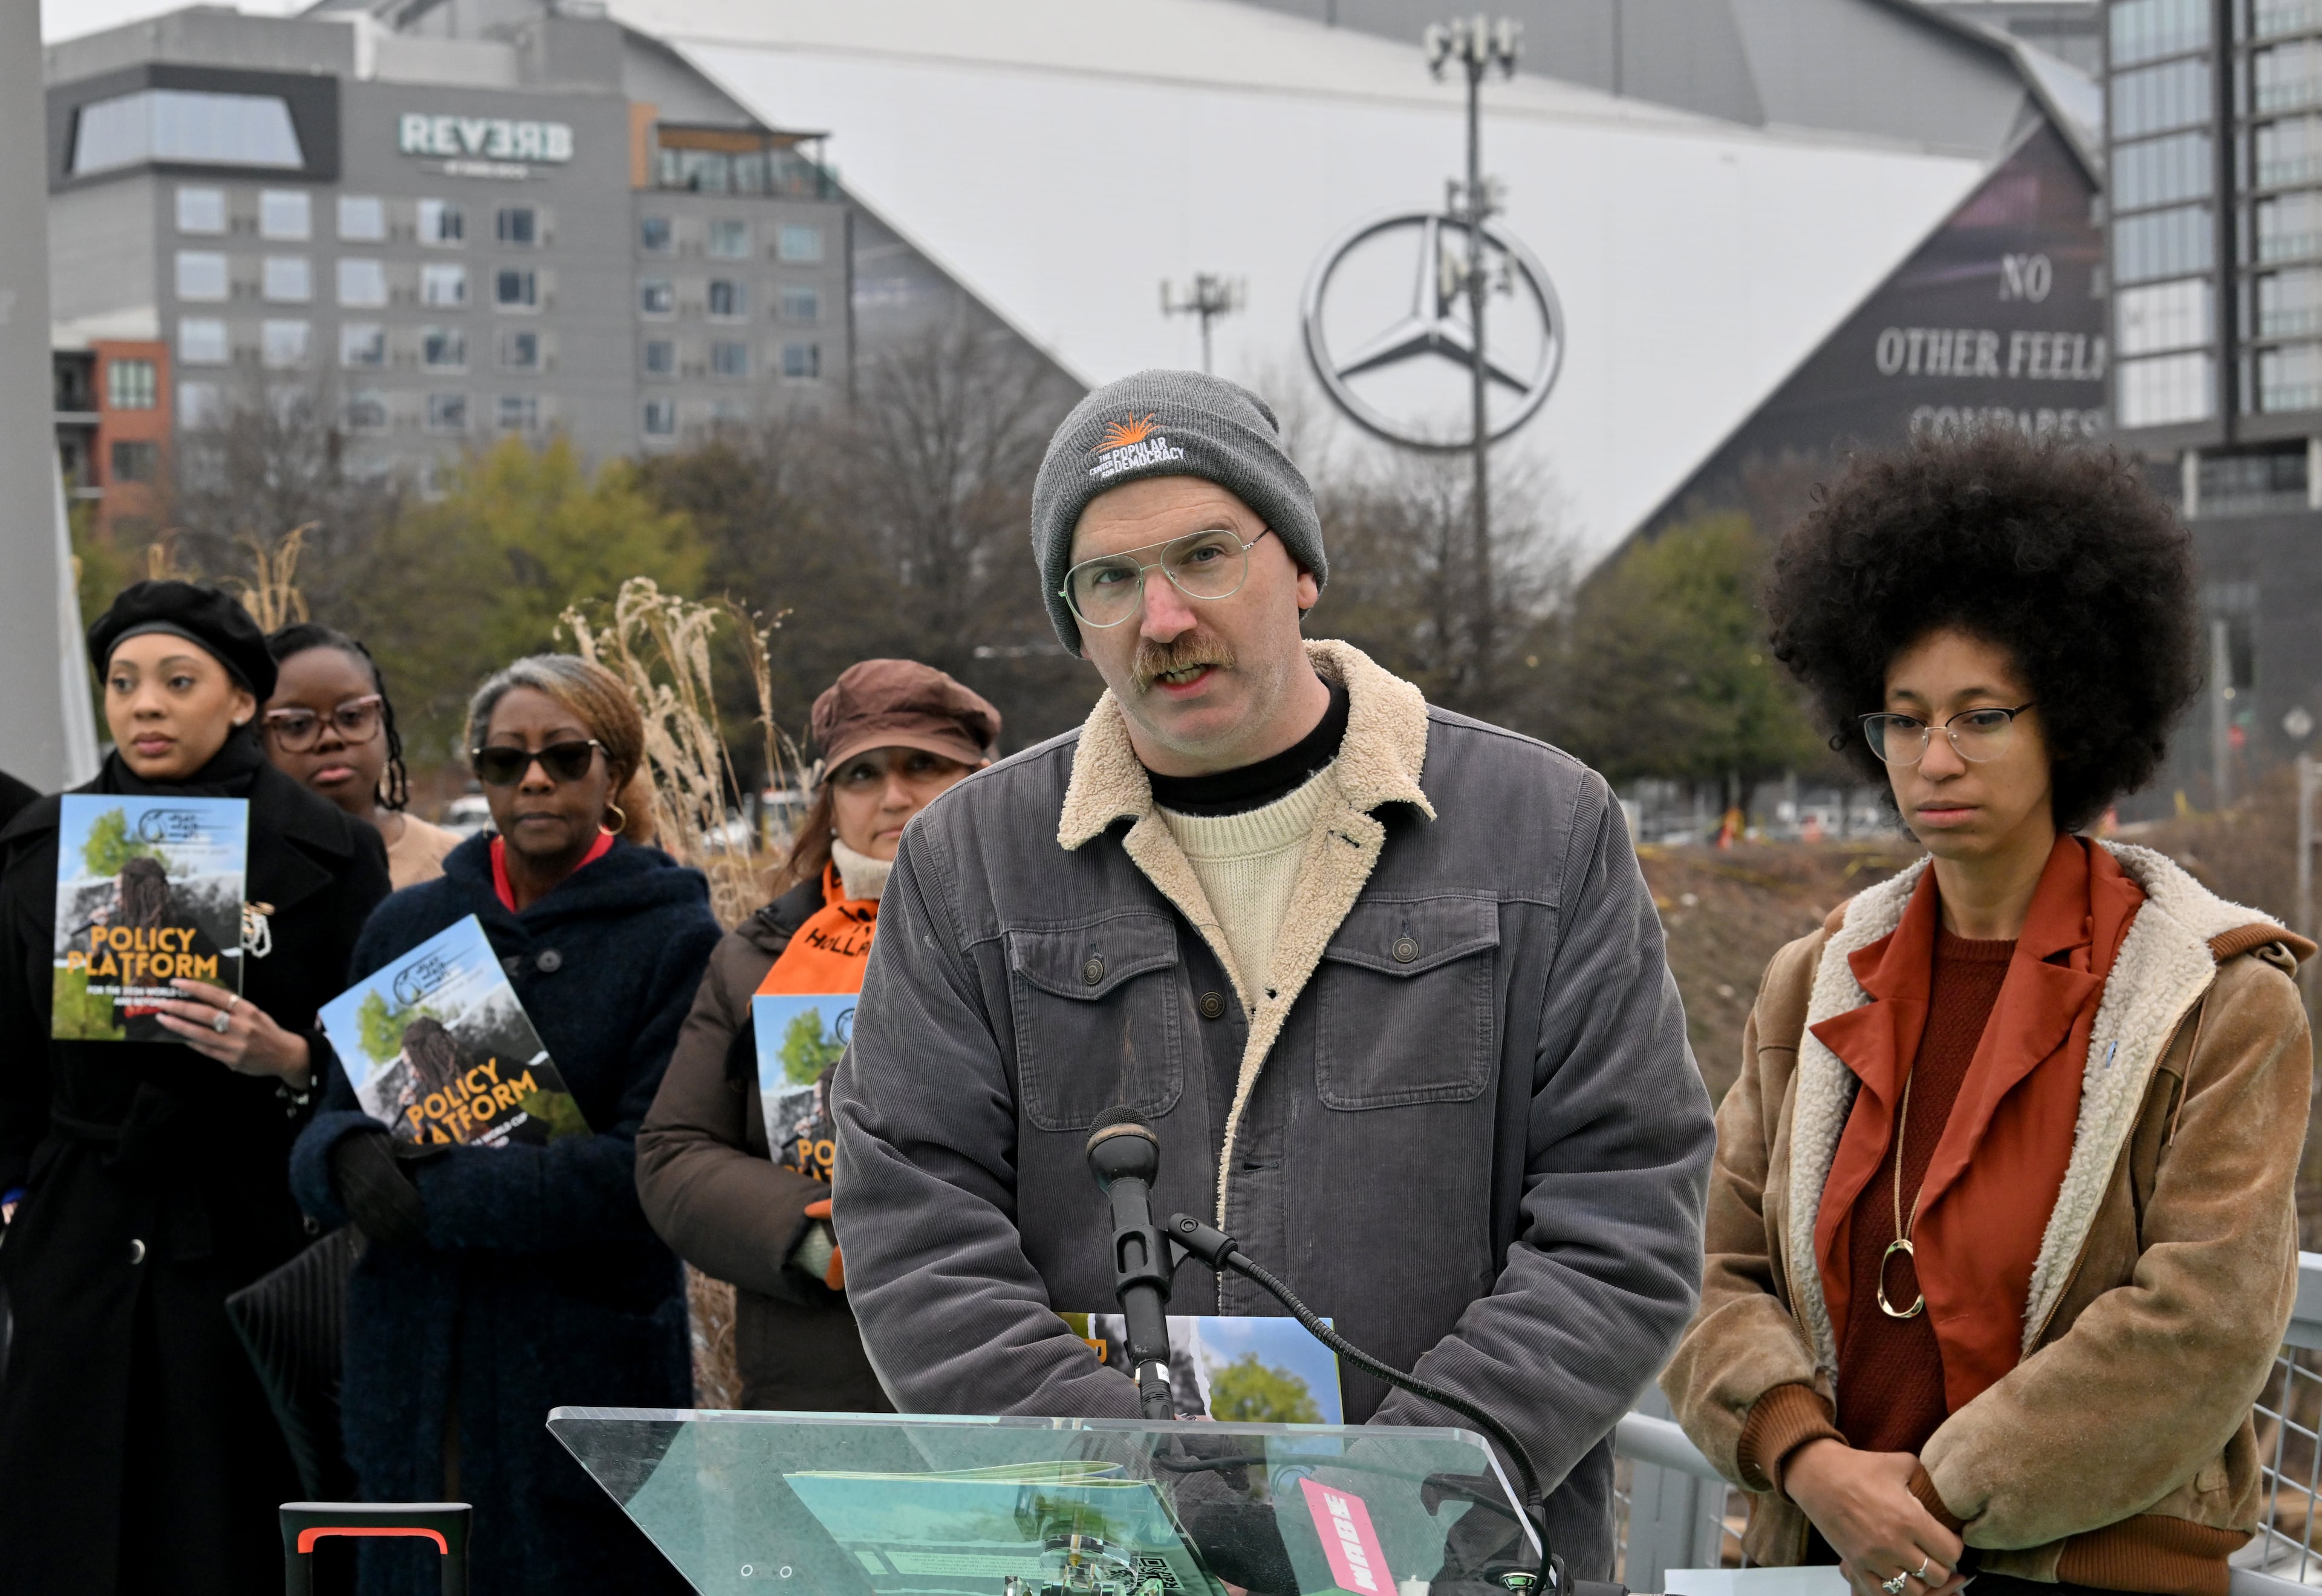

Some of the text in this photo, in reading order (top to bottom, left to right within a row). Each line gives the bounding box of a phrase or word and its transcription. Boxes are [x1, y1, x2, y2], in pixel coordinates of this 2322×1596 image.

[1999, 253, 2053, 303] NO
[1876, 326, 2000, 378] OTHER
[1098, 452, 1111, 462] THE
[1113, 436, 1168, 461] POPULAR
[1113, 447, 1185, 473] DEMOCRACY
[1090, 460, 1113, 476] CENTER
[1102, 468, 1115, 478] FOR
[90, 926, 197, 953] POLICY
[66, 950, 218, 985] PLATFORM
[406, 1056, 501, 1130] POLICY
[415, 1069, 538, 1146] ATFORM
[1323, 1491, 1379, 1592] WABE
